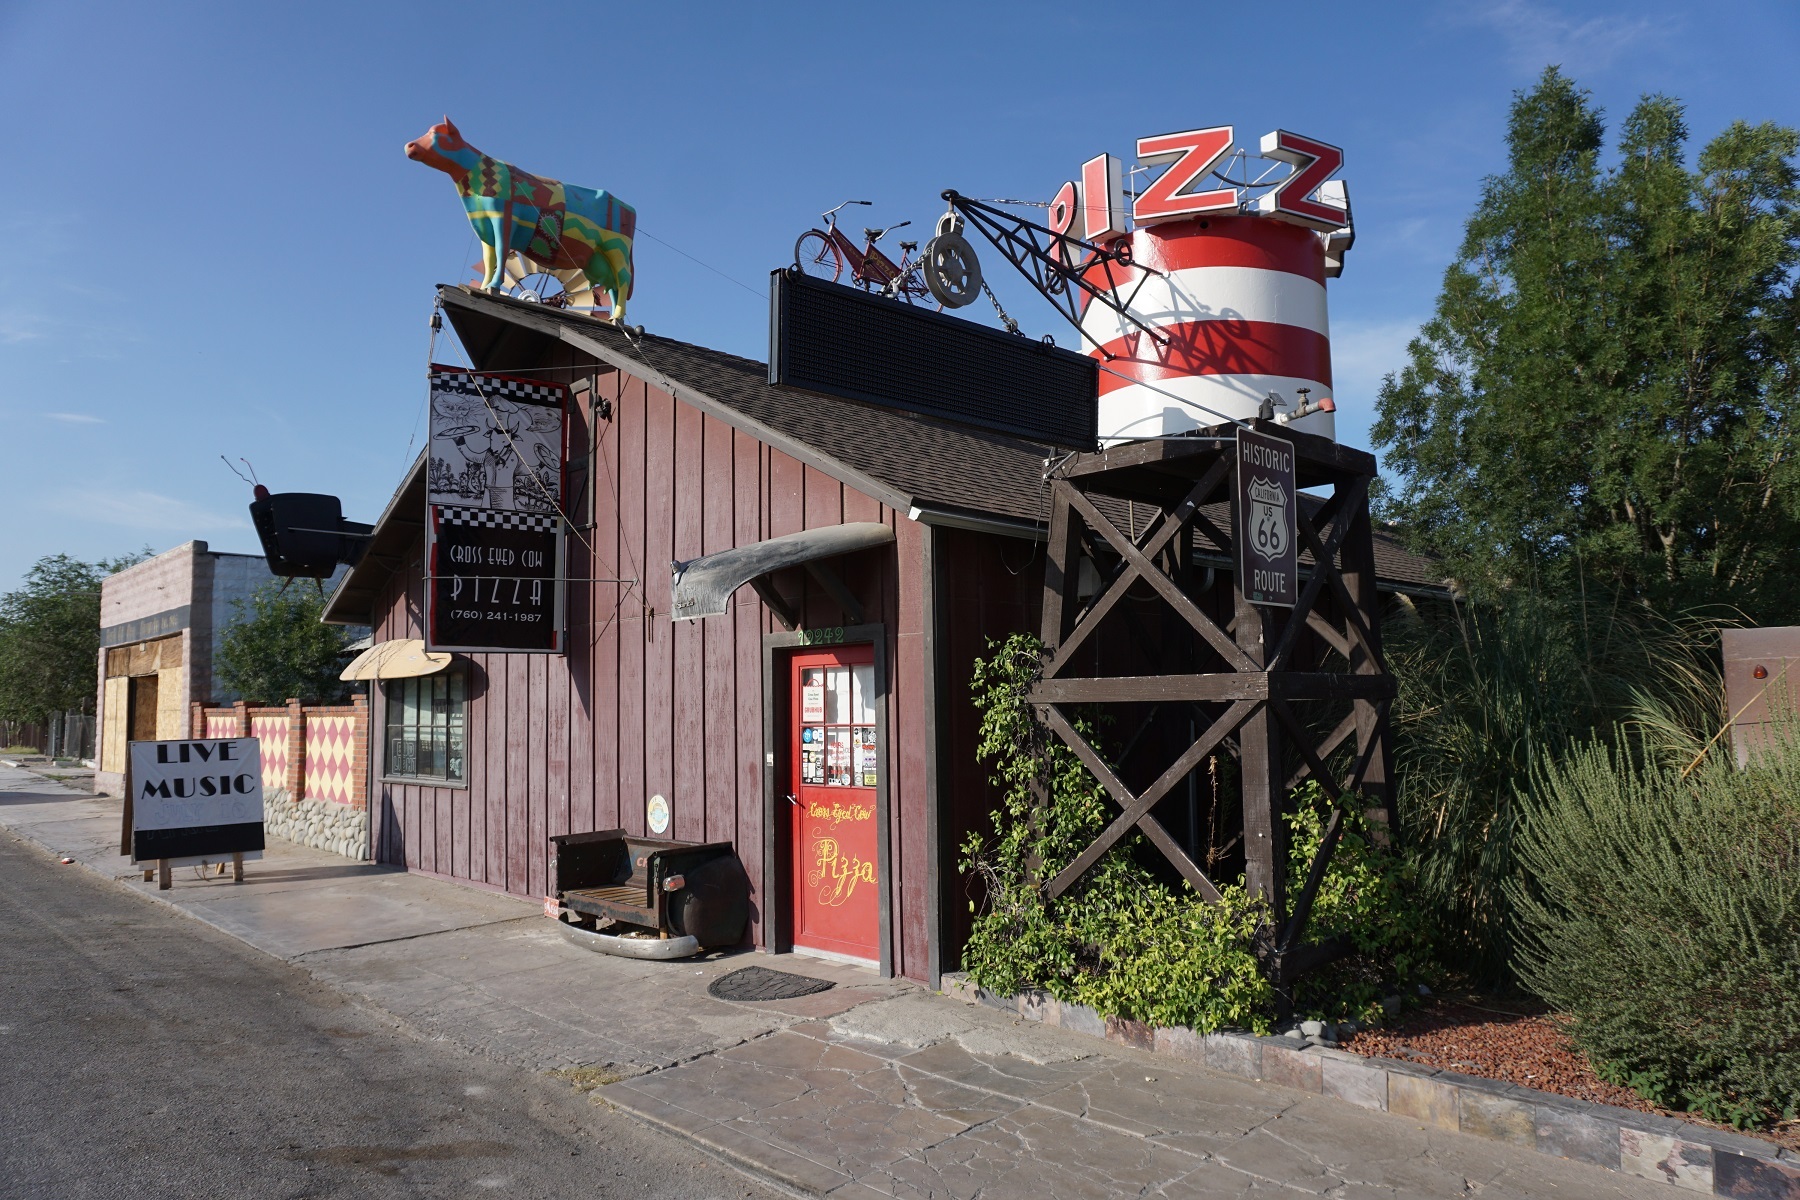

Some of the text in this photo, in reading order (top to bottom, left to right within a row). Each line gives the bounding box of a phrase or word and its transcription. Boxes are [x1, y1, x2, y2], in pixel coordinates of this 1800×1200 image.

[1243, 441, 1290, 473] HISTORIC
[1255, 486, 1281, 503] CALIFORNIA
[1263, 505, 1273, 518] US
[1258, 518, 1280, 550] 66
[450, 545, 543, 568] CROSS EYED COW
[450, 574, 541, 606] PIZZA
[1254, 569, 1286, 593] ROUTE
[450, 610, 542, 622] (760) 241-1987
[156, 741, 239, 764] LIVE
[141, 773, 255, 800] MUSIC
[812, 832, 878, 903] Pizza
